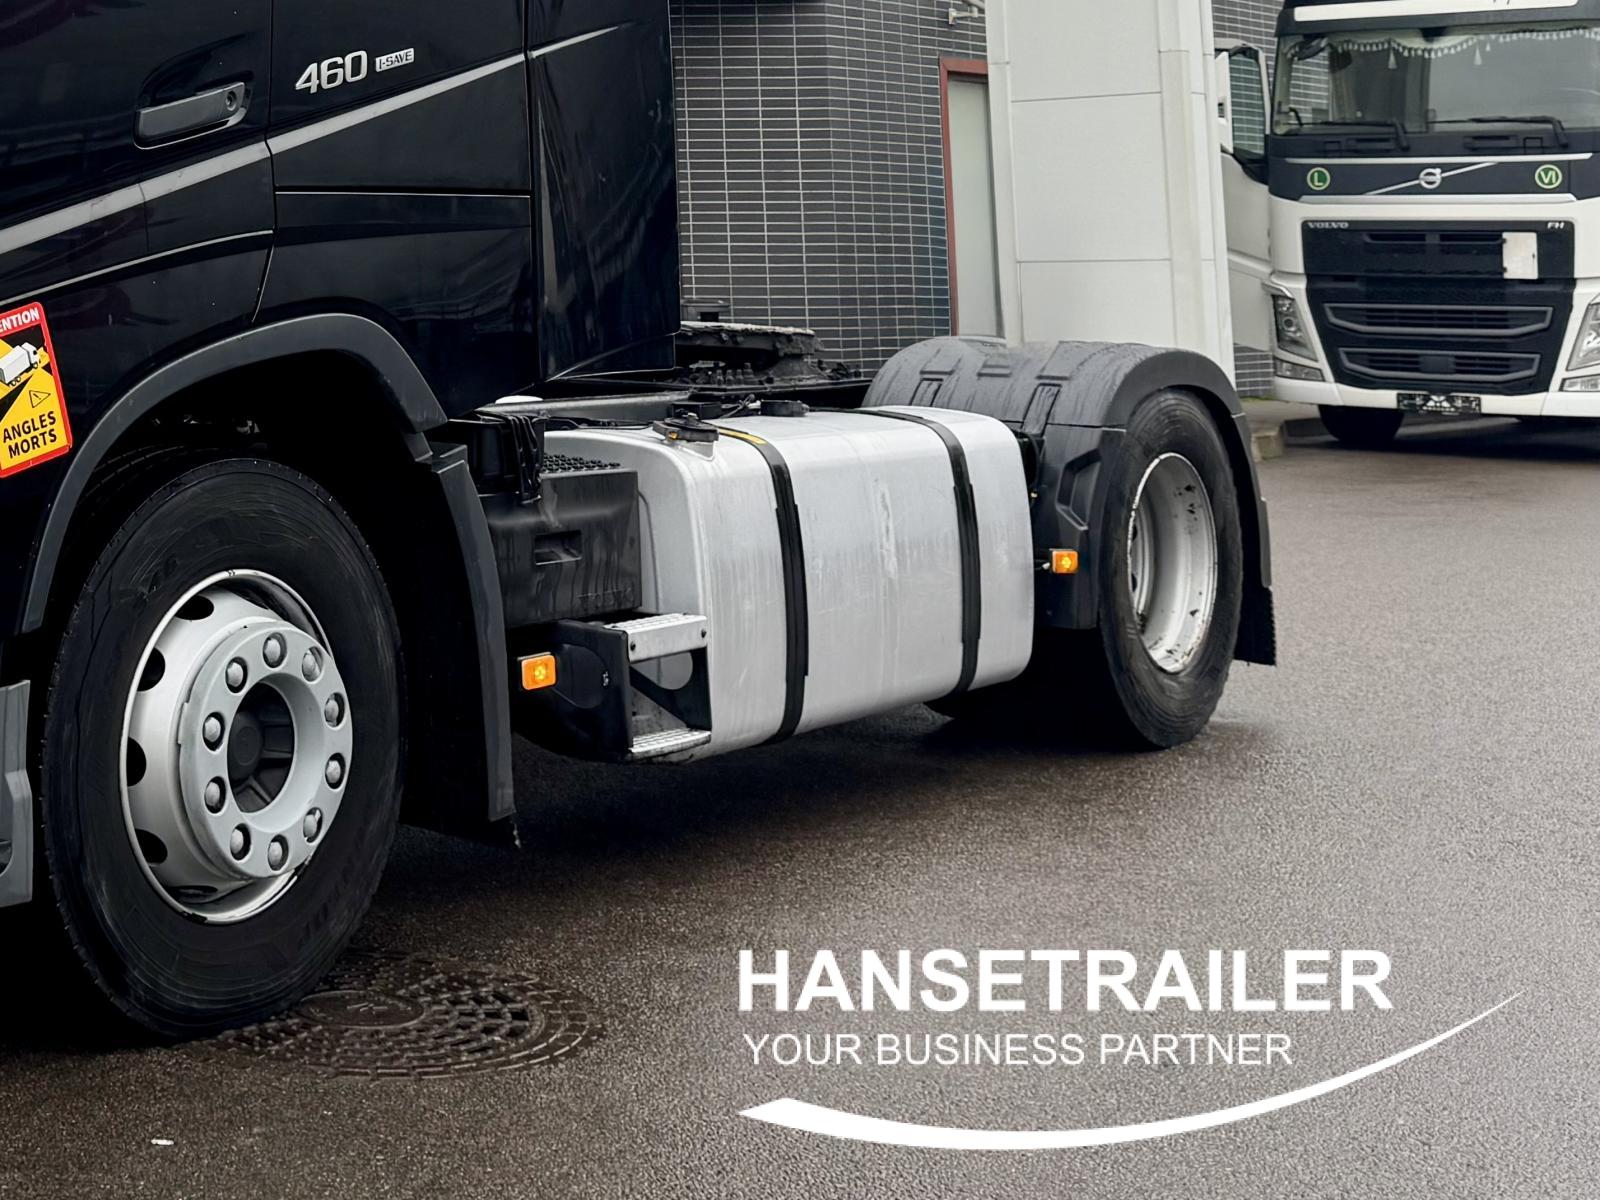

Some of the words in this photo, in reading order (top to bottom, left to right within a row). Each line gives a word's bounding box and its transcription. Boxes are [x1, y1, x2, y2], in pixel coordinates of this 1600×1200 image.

[294, 50, 368, 94] 460
[378, 50, 413, 71] I-SAVE
[1307, 221, 1349, 229] VOLVO
[1547, 221, 1565, 230] FH
[3, 410, 57, 443] ANGLES
[8, 428, 57, 459] MORTS
